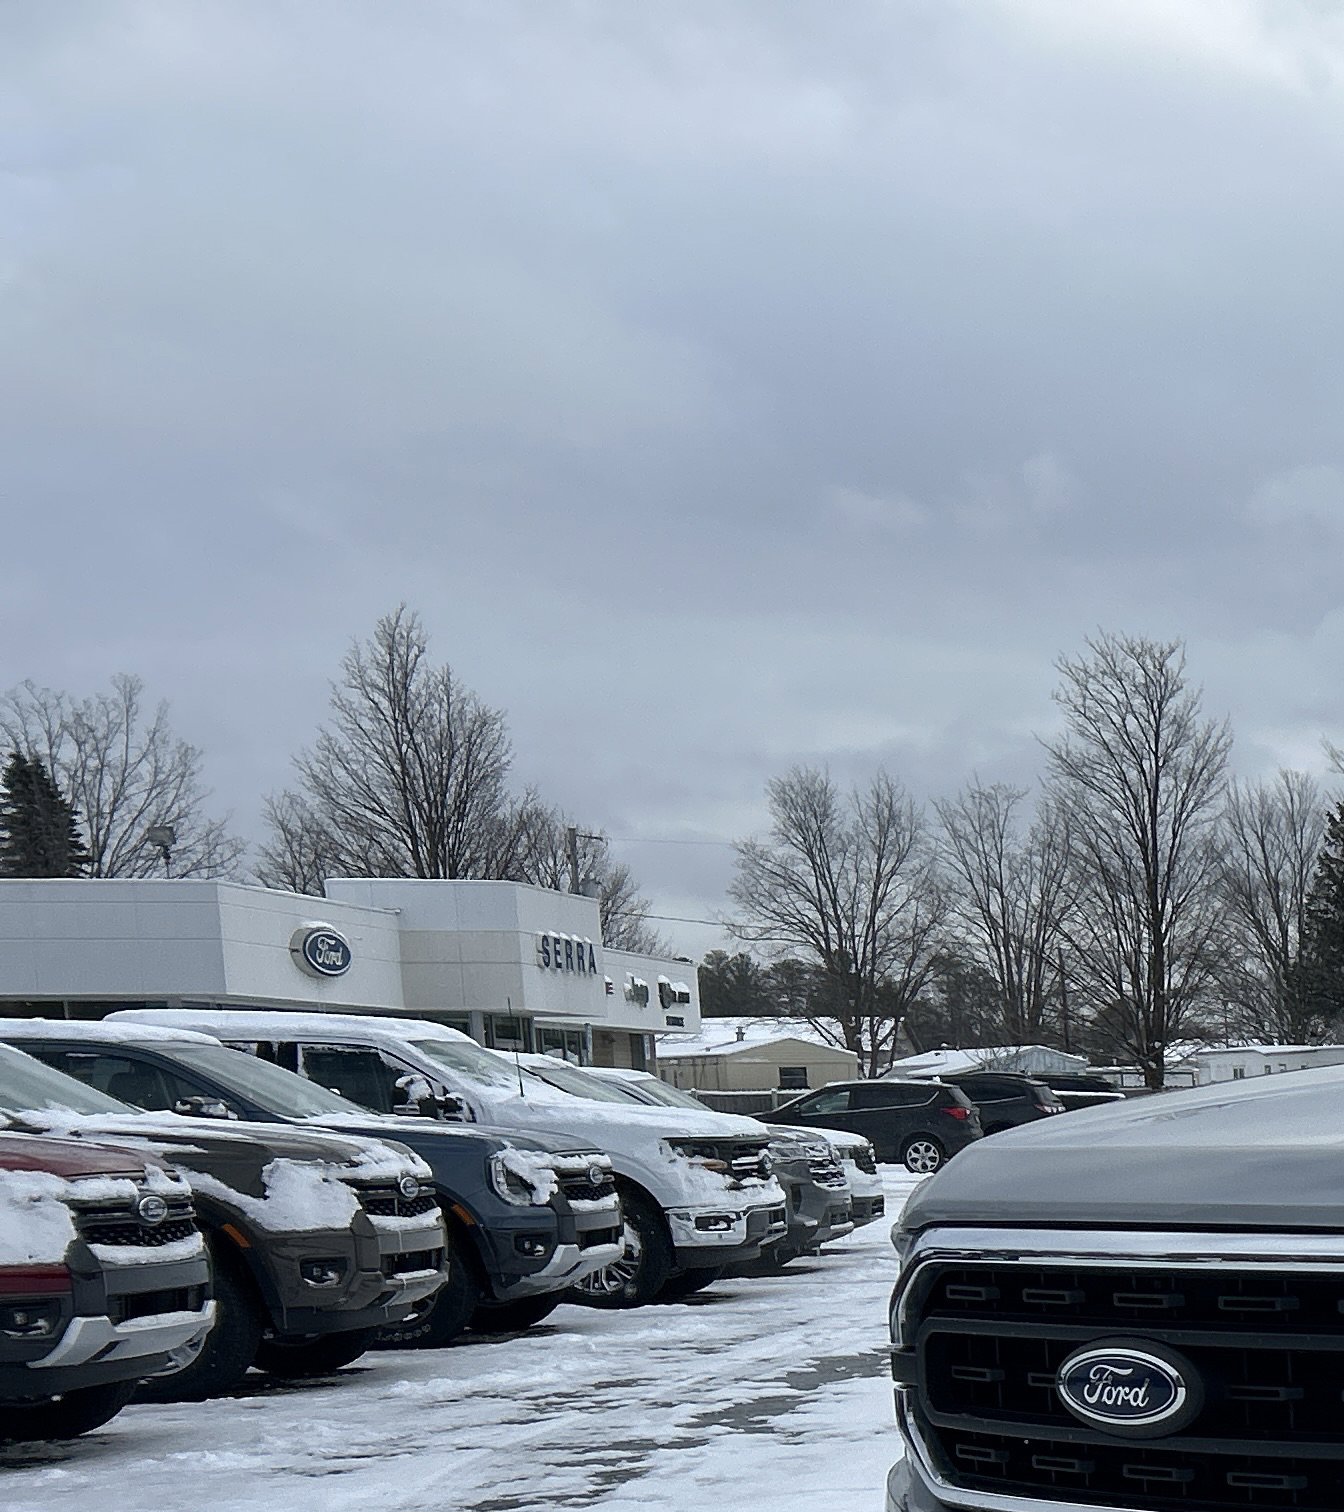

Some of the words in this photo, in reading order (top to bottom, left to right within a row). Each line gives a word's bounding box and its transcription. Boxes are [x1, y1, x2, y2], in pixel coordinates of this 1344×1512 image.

[316, 937, 342, 966] Ford
[541, 934, 598, 975] SERRA
[1083, 1364, 1151, 1408] Ford
